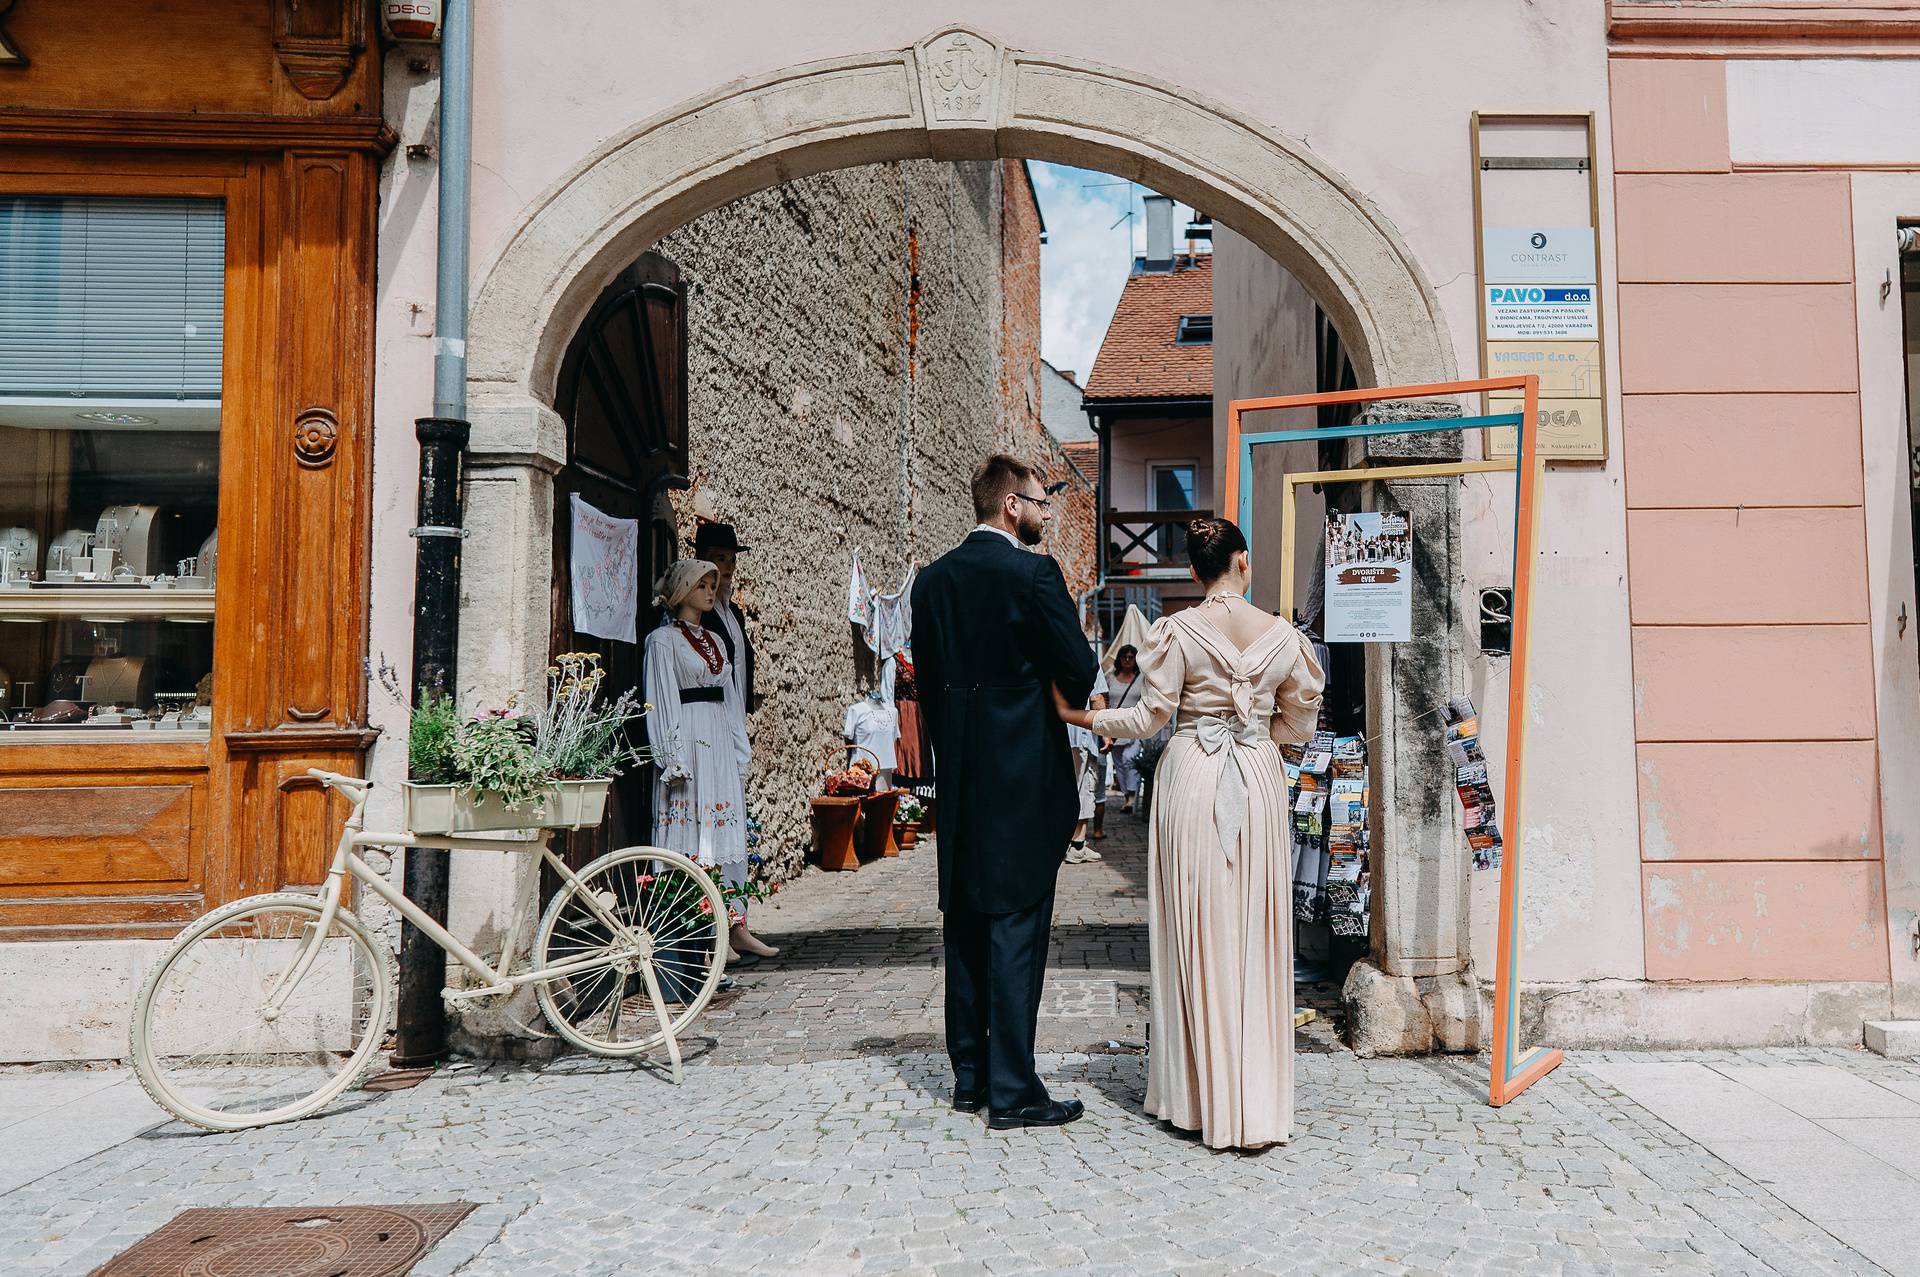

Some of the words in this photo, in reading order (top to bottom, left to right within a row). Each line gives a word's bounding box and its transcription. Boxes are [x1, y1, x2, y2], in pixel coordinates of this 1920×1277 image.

[388, 4, 431, 15] DSC
[1511, 253, 1568, 263] CONTRAST
[1490, 288, 1543, 303] PAVO
[1564, 292, 1591, 301] d.o.o.
[1494, 351, 1545, 362] VAGRAD
[1548, 351, 1579, 362] d.o.o.
[1352, 567, 1385, 576] DVORIŠTE
